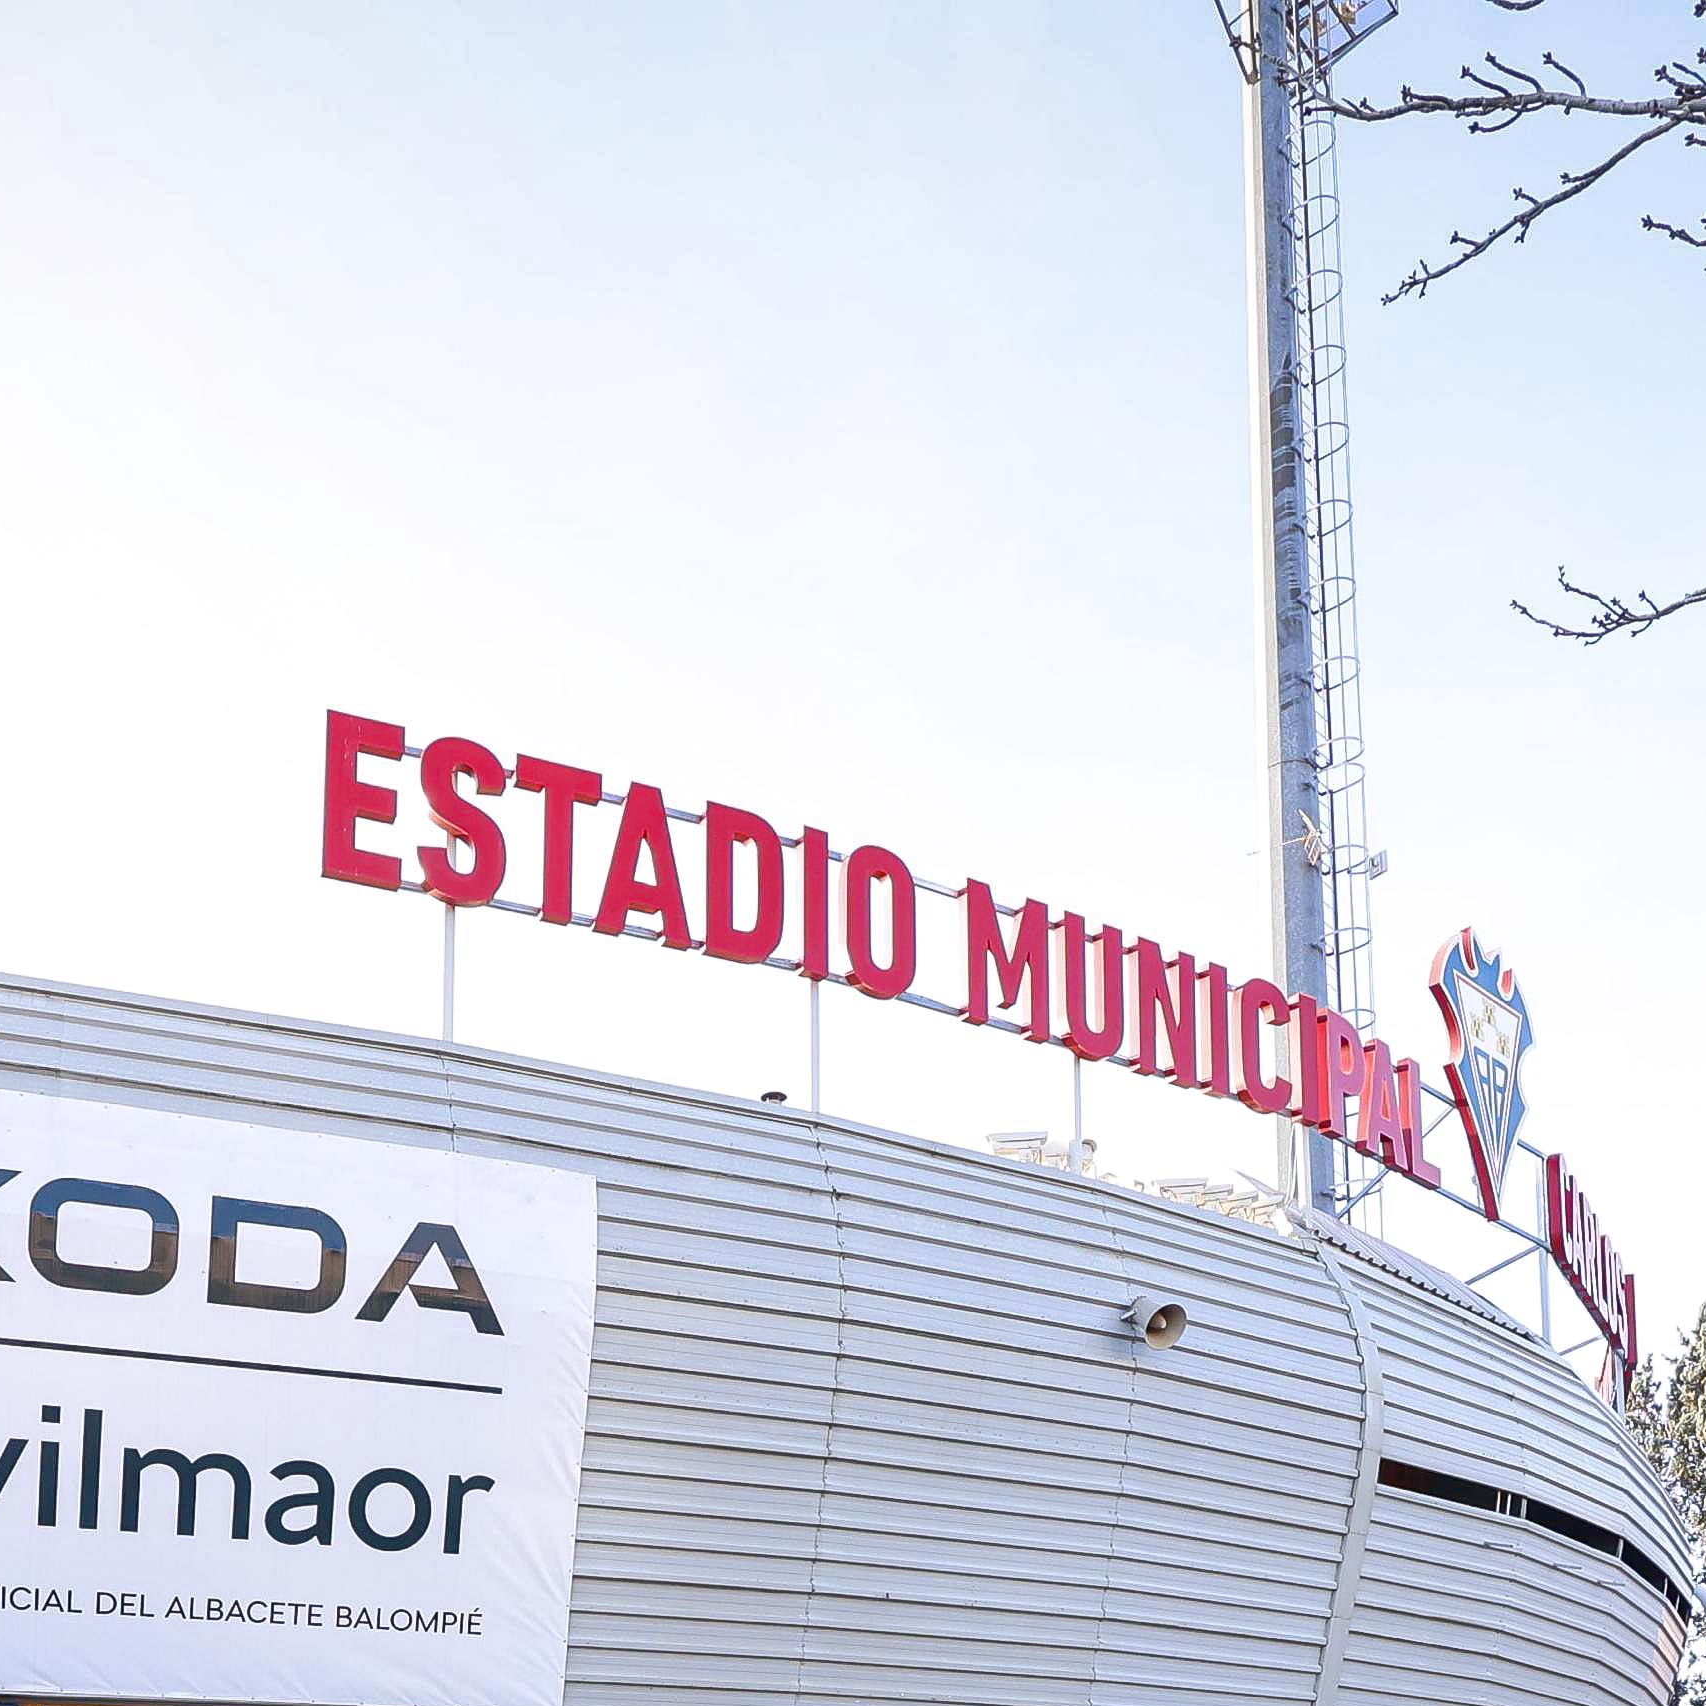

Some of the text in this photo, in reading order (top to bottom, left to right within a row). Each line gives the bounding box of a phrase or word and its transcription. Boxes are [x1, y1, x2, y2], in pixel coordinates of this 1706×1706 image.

[322, 708, 1442, 1190] ESTADIO MUNICIPAL
[95, 1591, 155, 1618] DEL
[164, 1596, 324, 1627] ALBACETE
[335, 1606, 484, 1636] BALOMPIÉ
